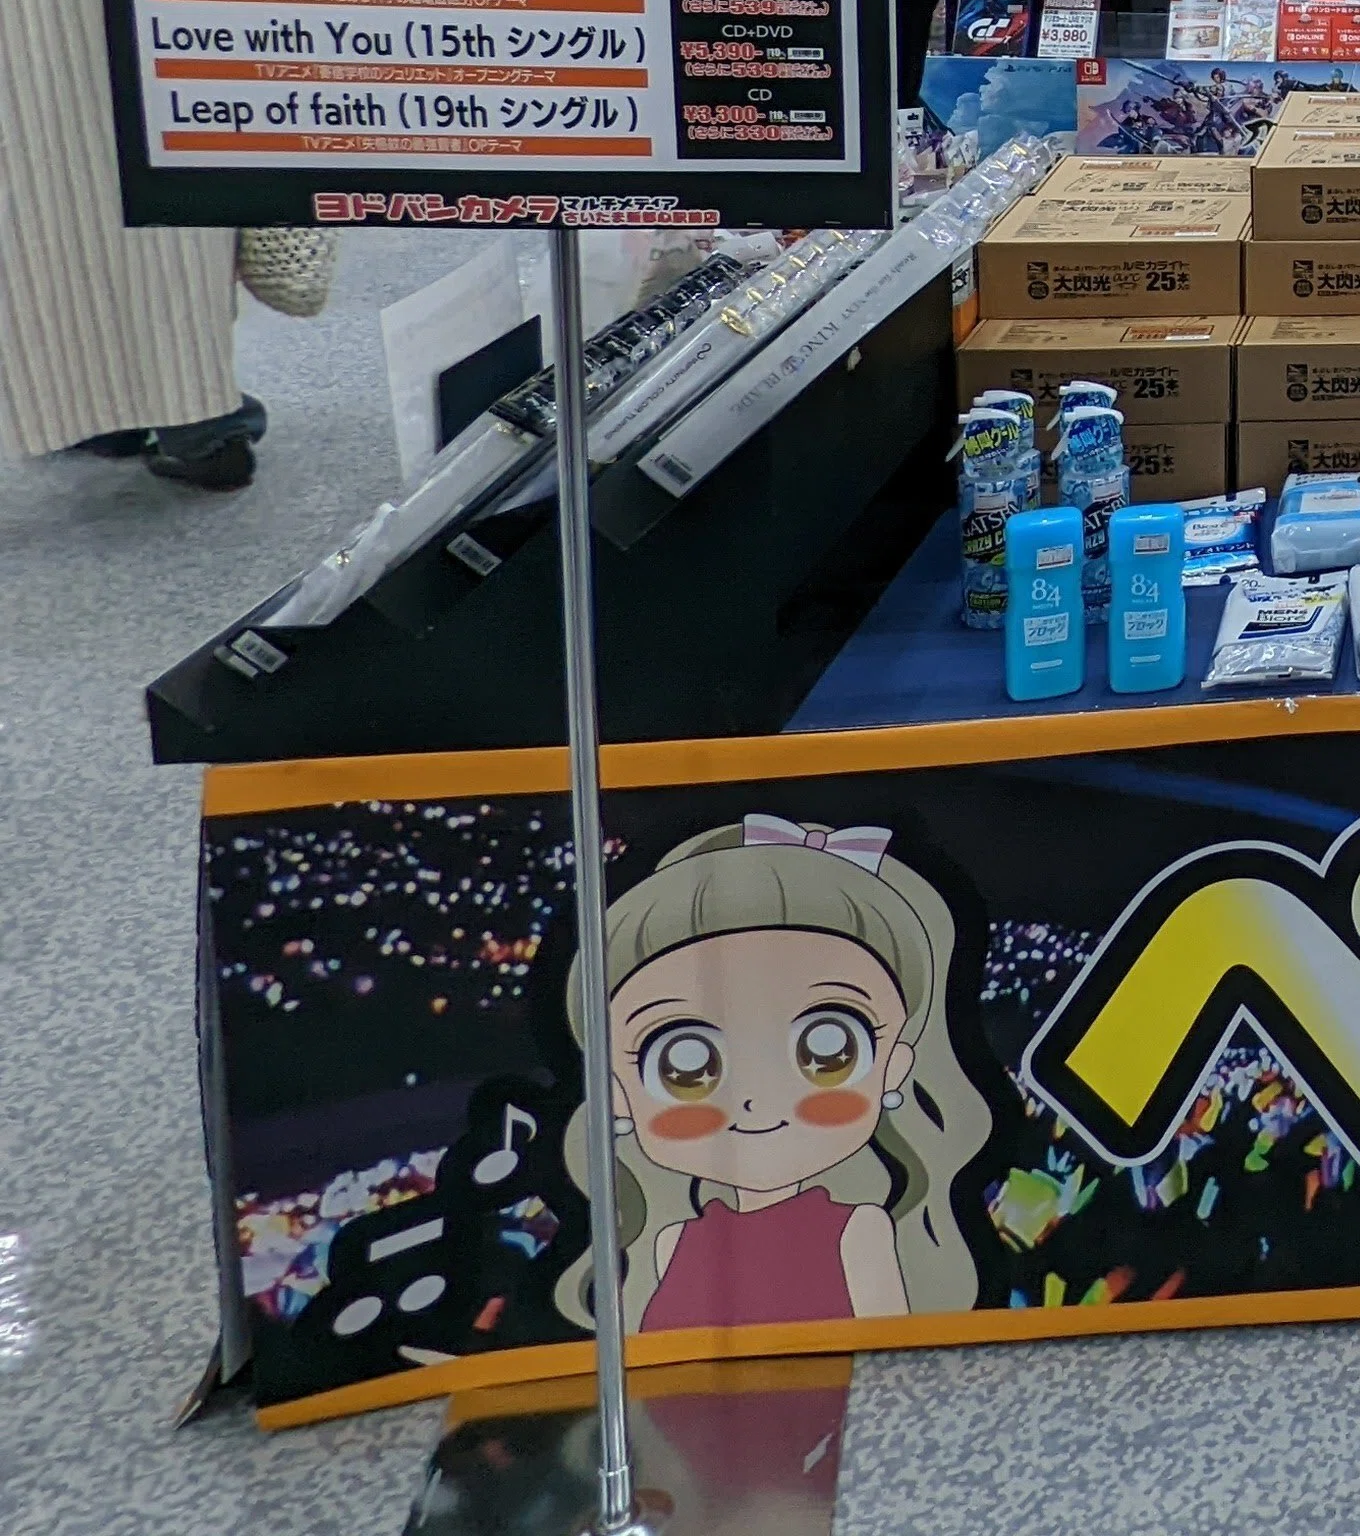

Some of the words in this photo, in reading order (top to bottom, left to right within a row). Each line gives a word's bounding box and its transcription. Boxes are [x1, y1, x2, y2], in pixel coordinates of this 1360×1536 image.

[152, 18, 234, 51] Love
[245, 19, 314, 54] with
[325, 22, 391, 56] You
[406, 22, 495, 60] (15th
[722, 23, 793, 39] CD+DVD
[748, 88, 773, 102] CD
[171, 91, 254, 131] Leap
[266, 91, 299, 125] of
[310, 91, 386, 127] faith
[400, 94, 488, 130] (19th
[313, 192, 561, 223] ヨドバシカメラ
[563, 196, 679, 212] マルチメディア
[1122, 259, 1191, 273] ルミカライト
[1053, 273, 1112, 294] 大閃光
